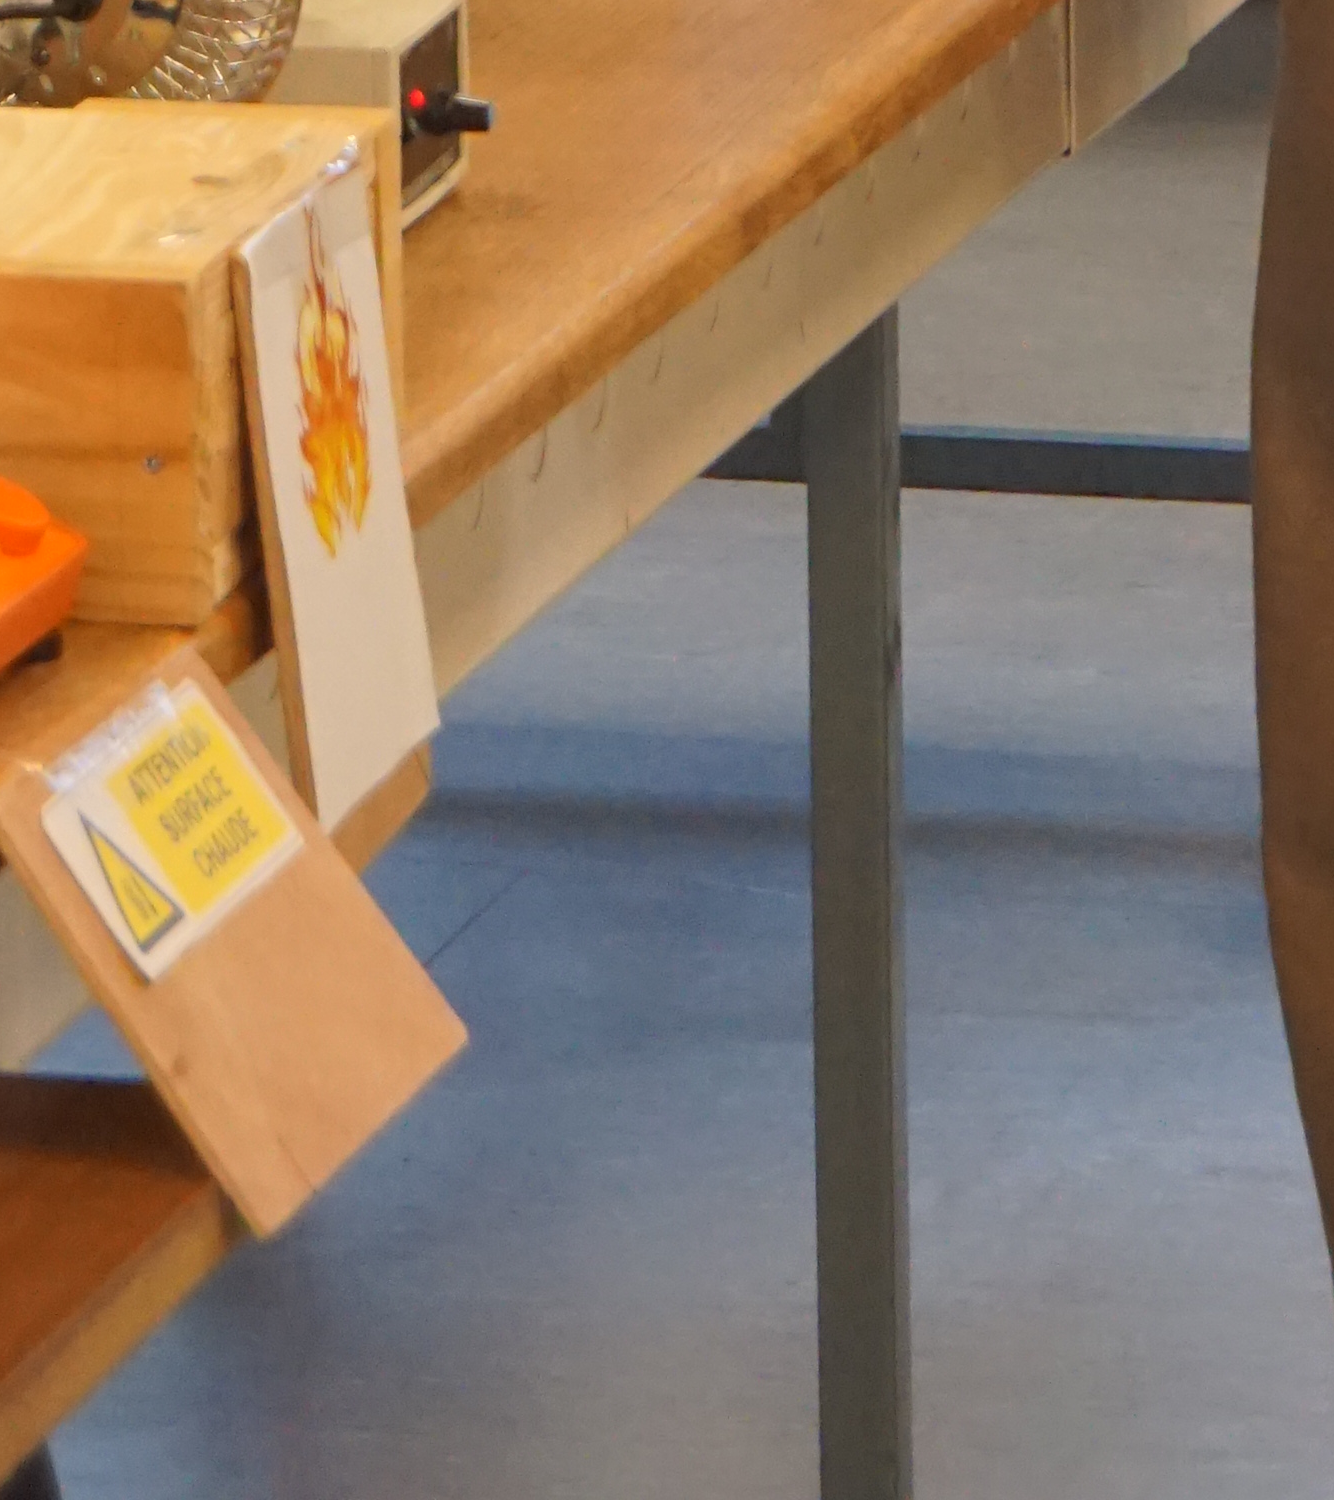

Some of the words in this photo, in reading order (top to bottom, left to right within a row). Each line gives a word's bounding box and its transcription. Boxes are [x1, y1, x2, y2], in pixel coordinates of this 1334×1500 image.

[128, 722, 211, 805] ATTENTION
[158, 765, 232, 843] SURFACE
[193, 808, 259, 878] CHAUDE
